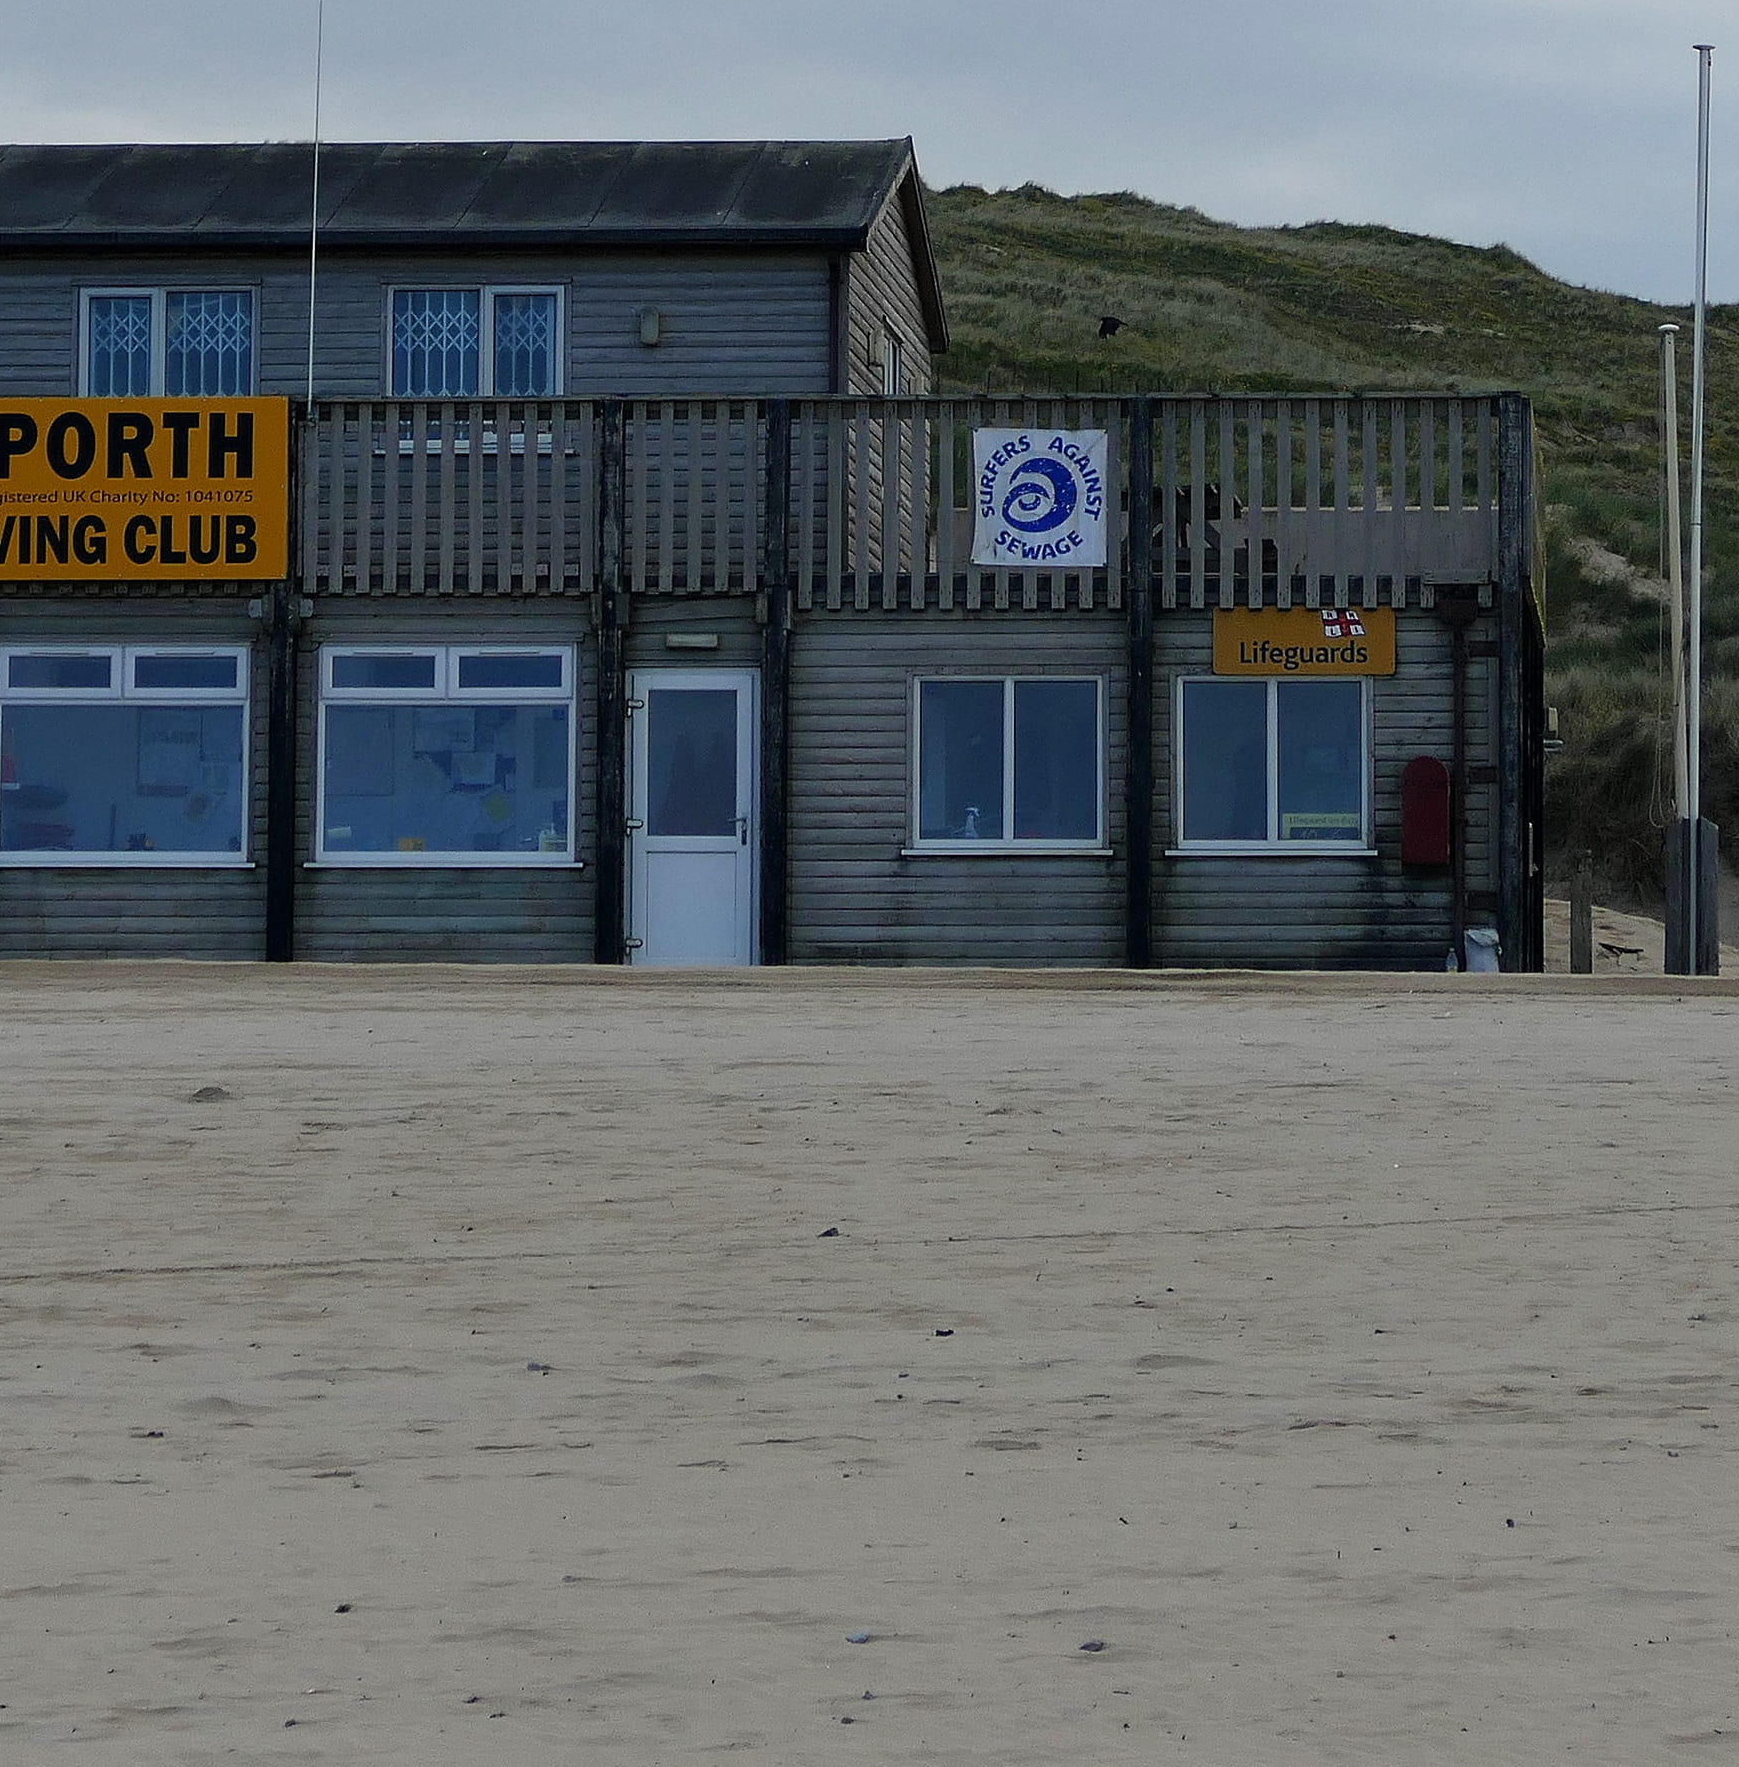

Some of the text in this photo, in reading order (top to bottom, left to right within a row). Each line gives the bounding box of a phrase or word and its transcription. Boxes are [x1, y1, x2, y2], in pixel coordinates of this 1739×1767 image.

[979, 434, 1103, 522] SURFERS AGAINST
[63, 490, 87, 503] UK
[89, 490, 148, 506] Charity
[152, 490, 180, 503] No:
[184, 489, 253, 503] 1041075
[123, 514, 258, 565] CLUB
[993, 530, 1084, 561] SEWAGE
[1239, 639, 1369, 671] Lifeguards
